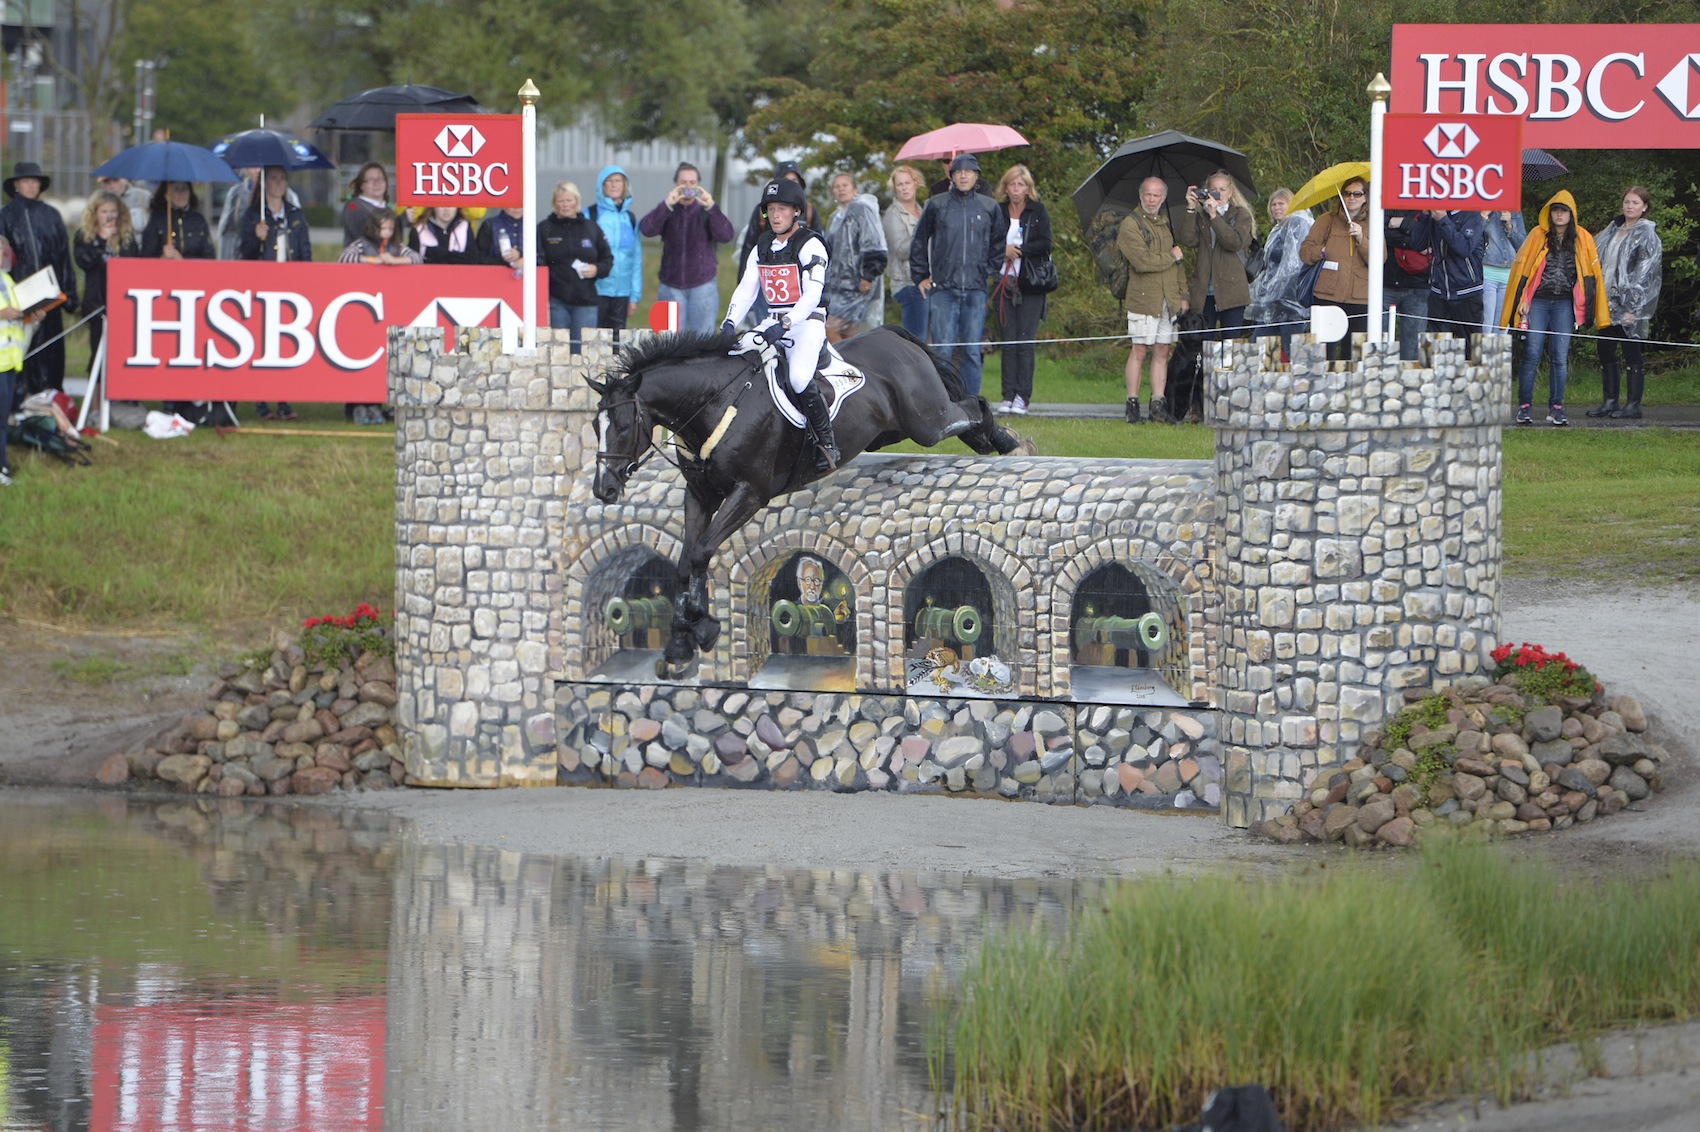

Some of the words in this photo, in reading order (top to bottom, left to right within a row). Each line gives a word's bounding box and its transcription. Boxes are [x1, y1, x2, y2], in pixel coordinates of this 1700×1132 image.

[1417, 52, 1645, 121] HSBC
[412, 161, 509, 196] HSBC
[1398, 163, 1503, 200] HSBC
[765, 279, 790, 302] 53
[125, 288, 386, 371] HSBC
